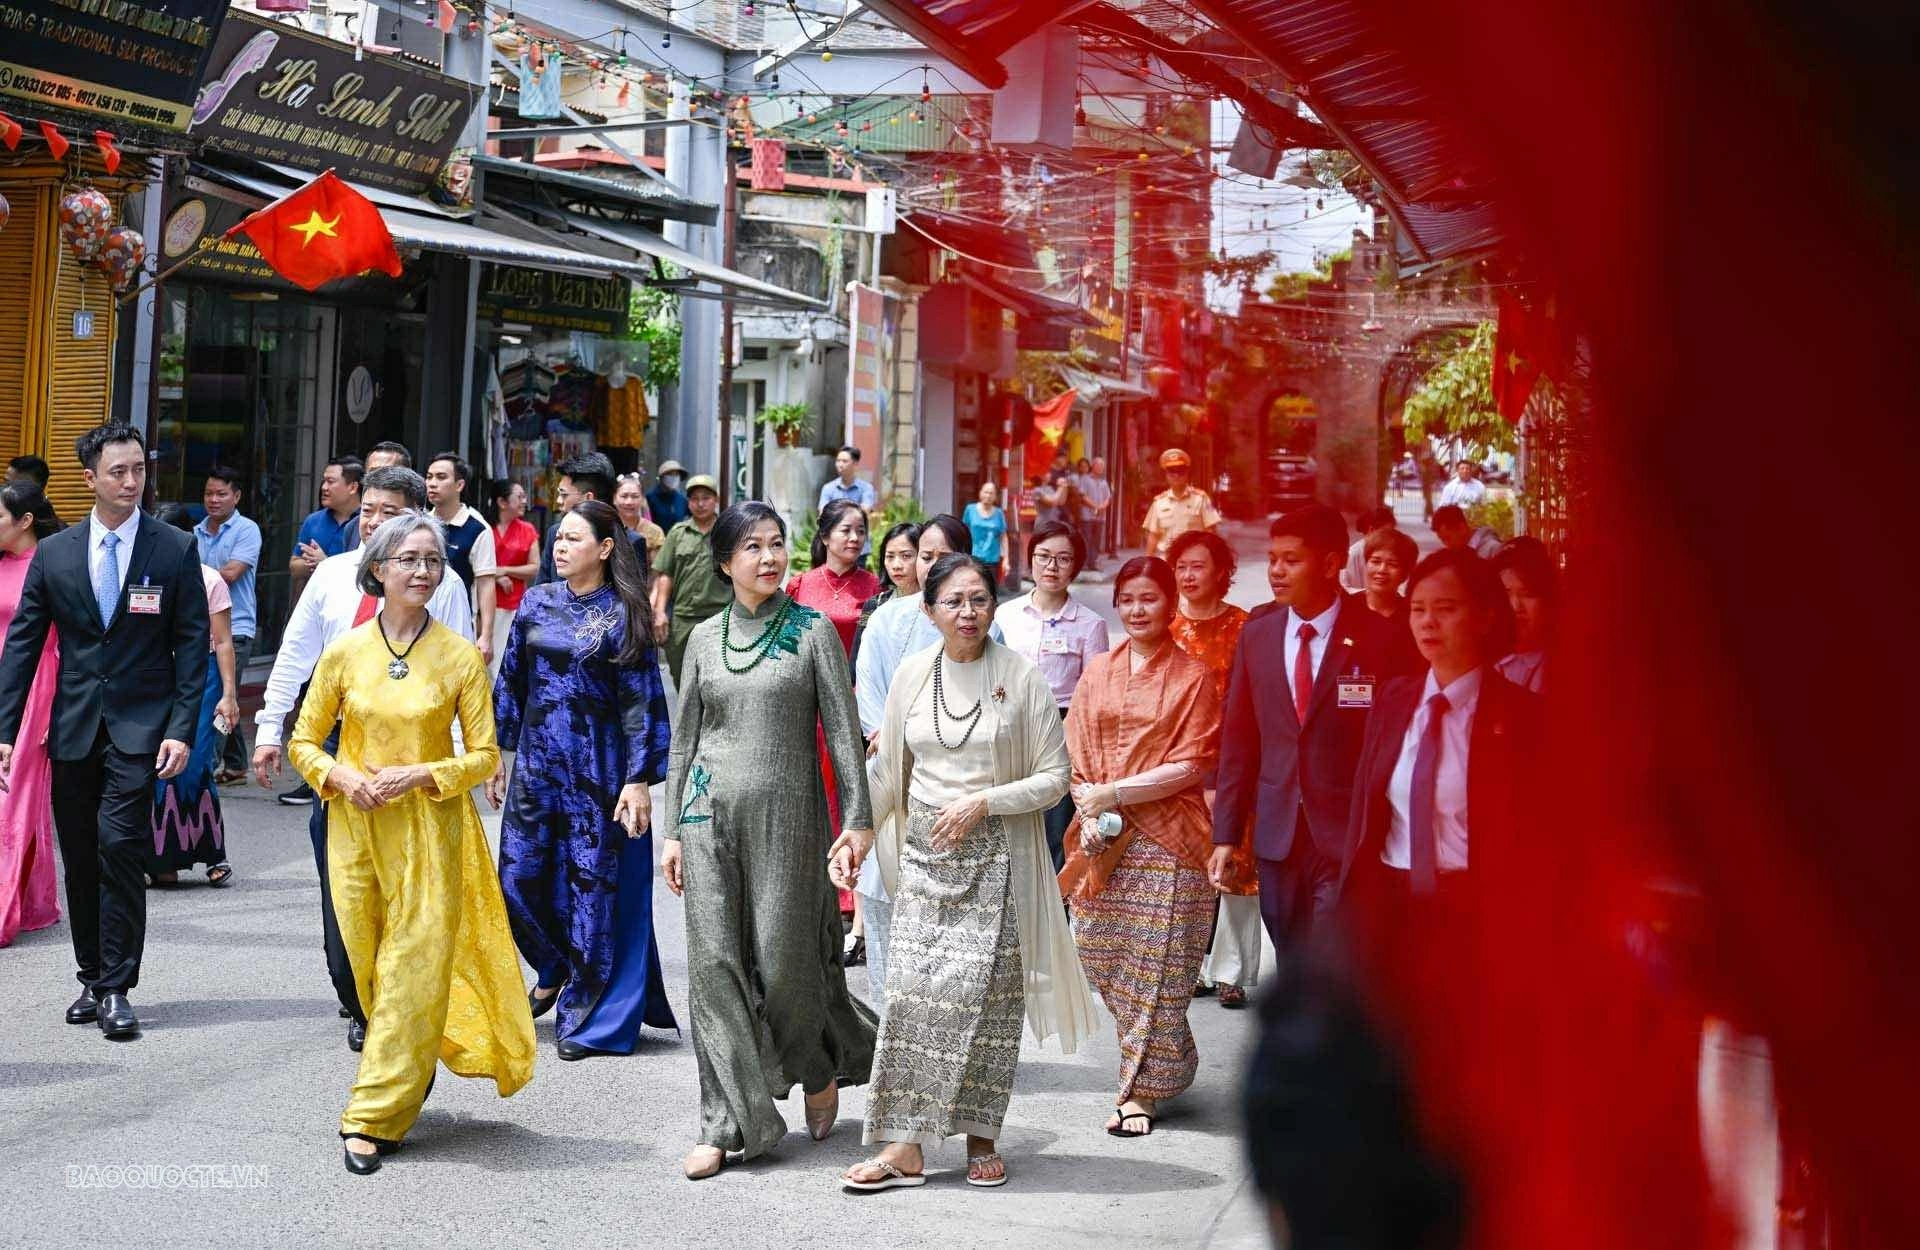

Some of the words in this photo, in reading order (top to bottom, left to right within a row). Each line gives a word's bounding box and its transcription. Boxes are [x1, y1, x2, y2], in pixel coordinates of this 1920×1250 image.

[40, 17, 114, 55] TRADITIONAL
[259, 58, 318, 108] Hà
[316, 72, 402, 128] Linh
